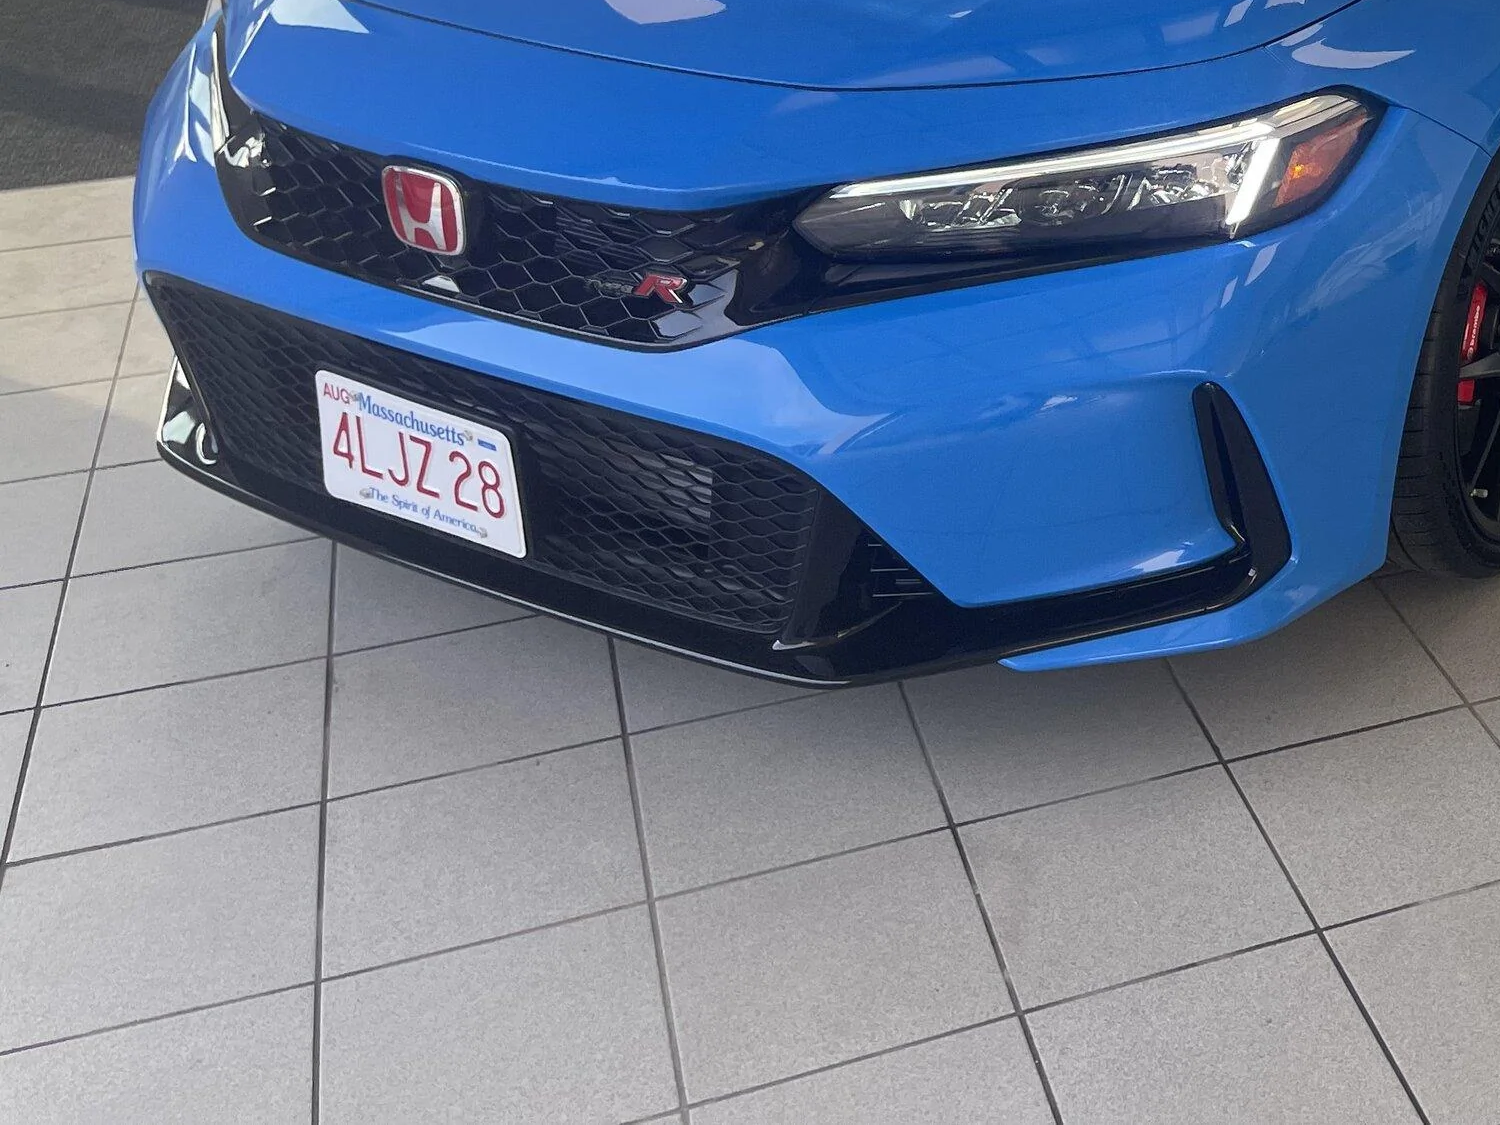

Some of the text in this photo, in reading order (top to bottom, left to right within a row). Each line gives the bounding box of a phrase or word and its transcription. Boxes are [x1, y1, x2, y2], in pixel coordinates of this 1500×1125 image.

[323, 382, 350, 404] AUG
[358, 392, 464, 445] Massachusetts
[371, 487, 478, 533] The Spirit of America
